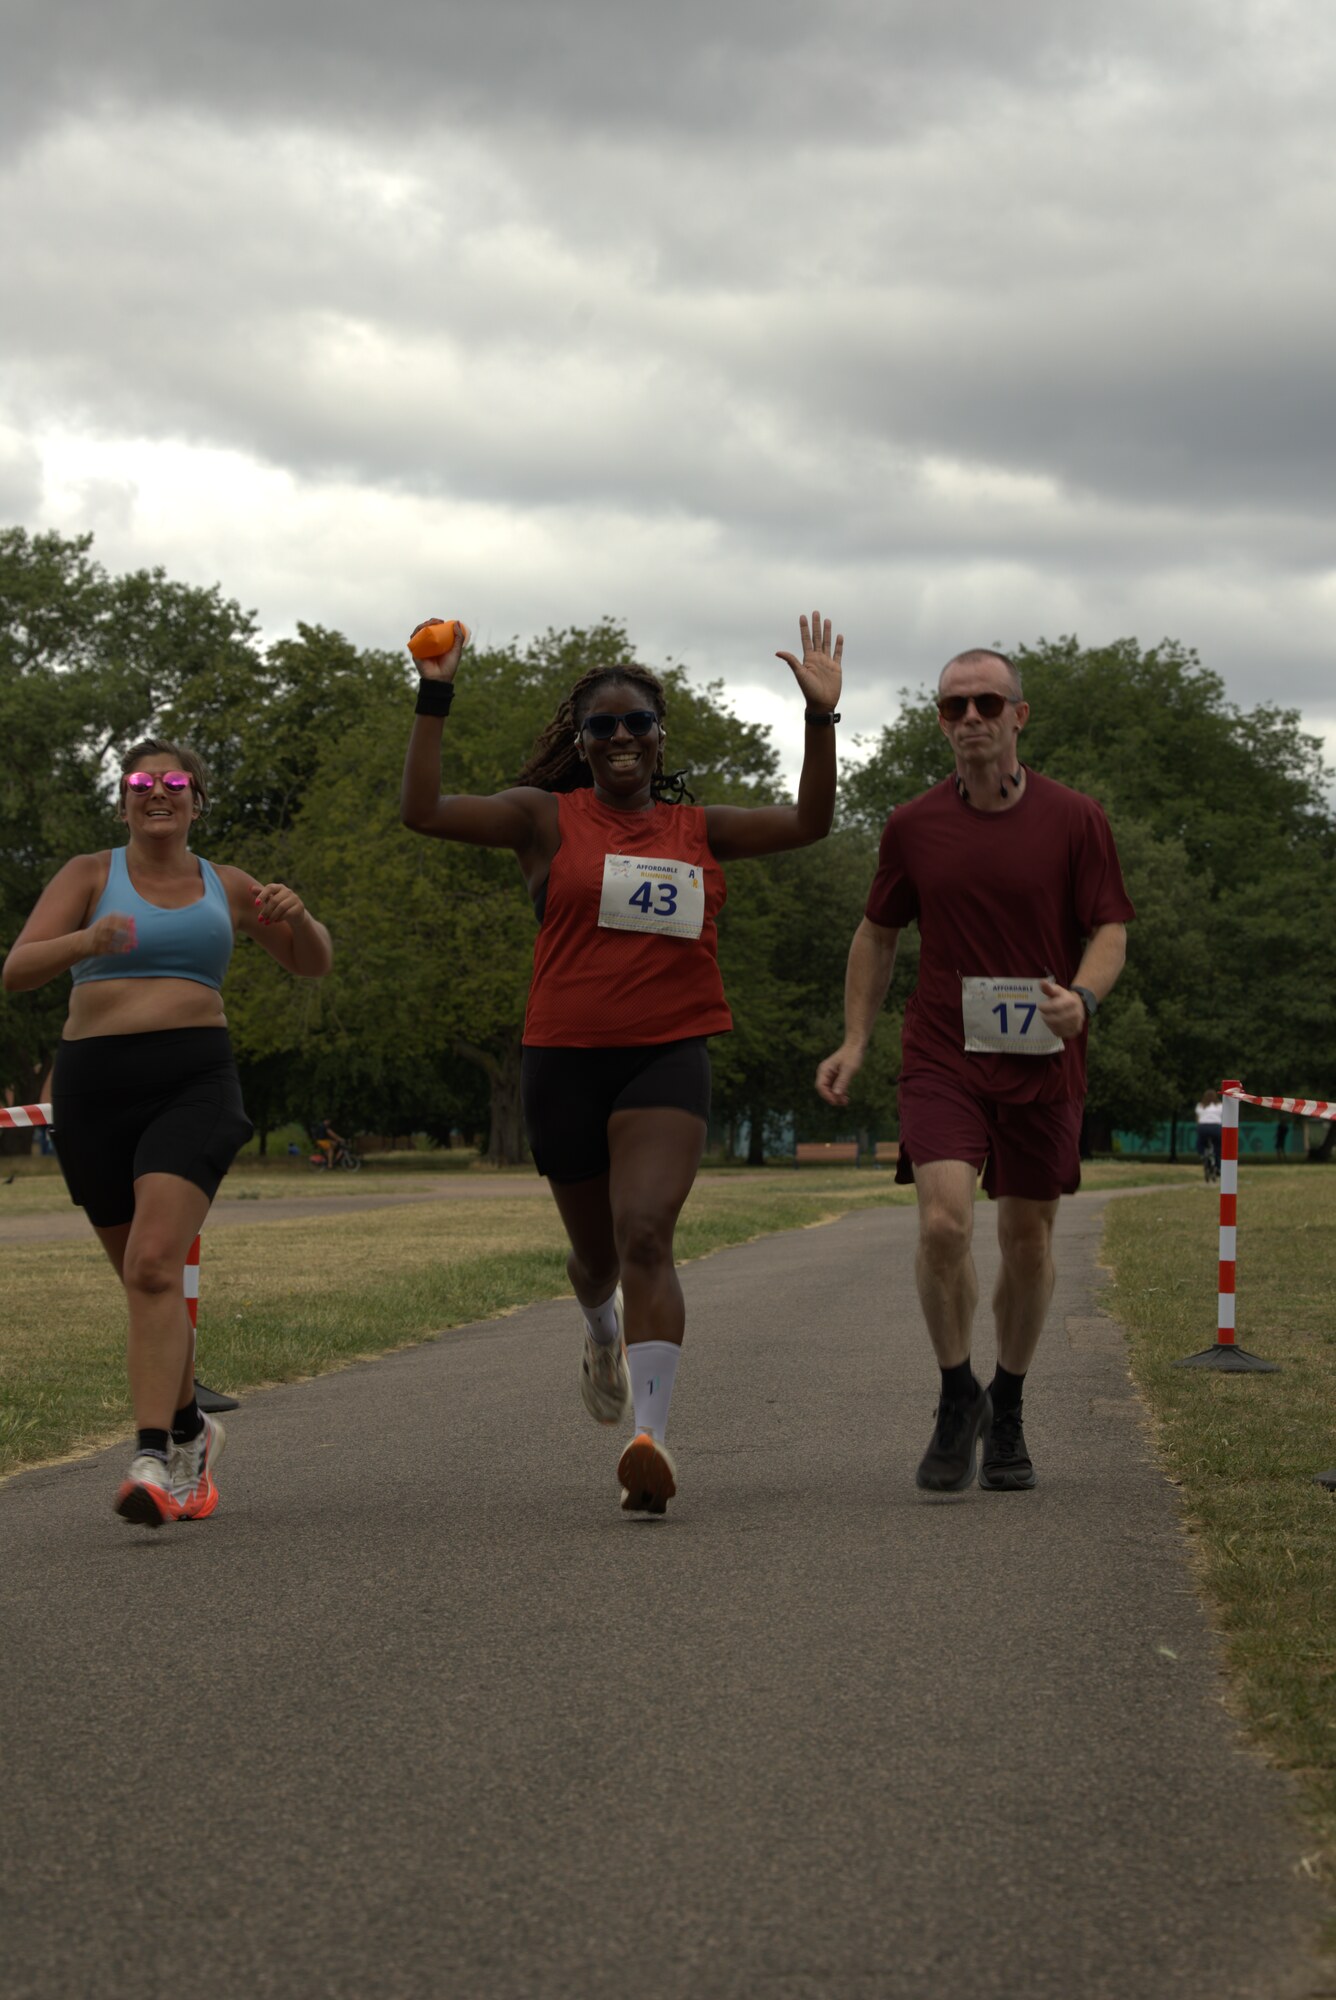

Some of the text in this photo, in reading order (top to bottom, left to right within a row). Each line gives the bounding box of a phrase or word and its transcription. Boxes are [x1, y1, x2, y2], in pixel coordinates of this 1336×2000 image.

[636, 864, 678, 873] AFFORDABLE
[640, 872, 673, 880] RUNNING
[628, 881, 678, 916] 43
[992, 1003, 1037, 1034] 17
